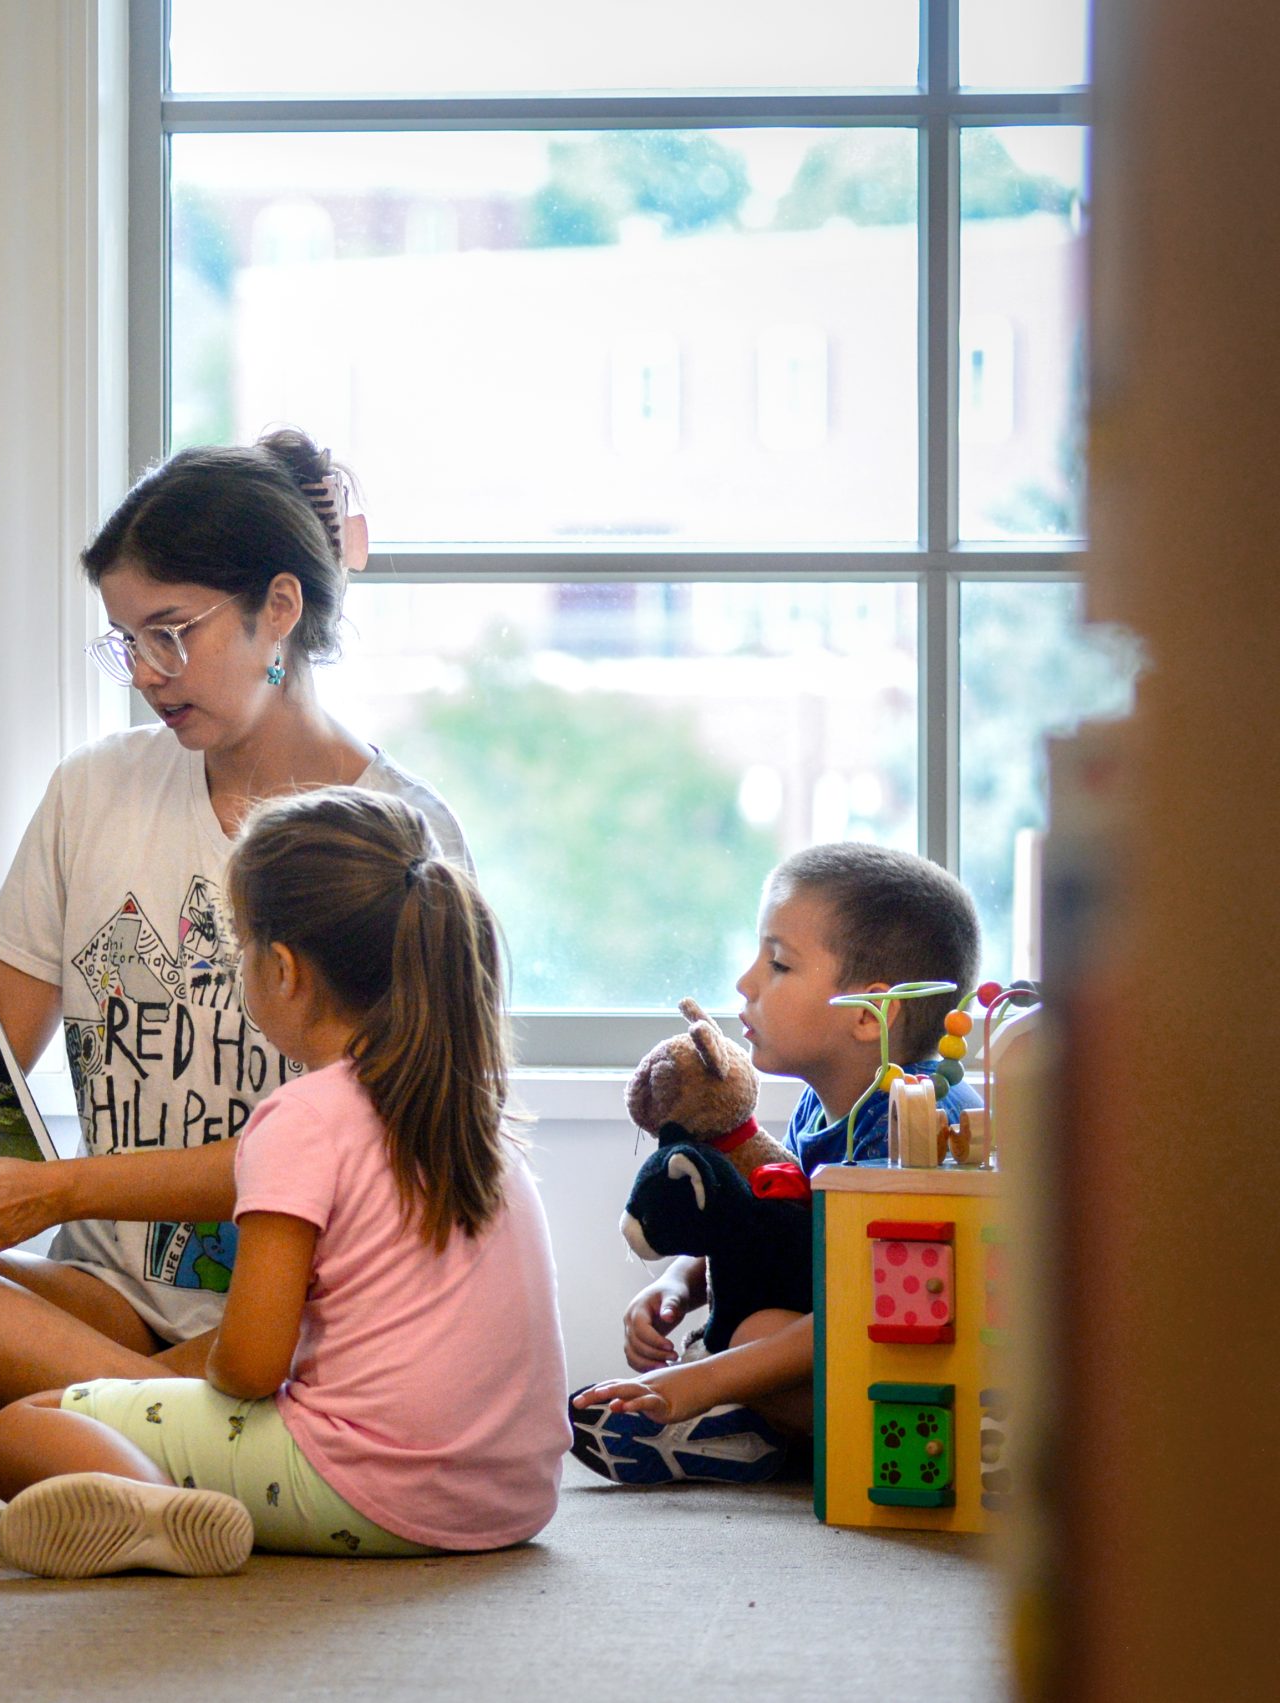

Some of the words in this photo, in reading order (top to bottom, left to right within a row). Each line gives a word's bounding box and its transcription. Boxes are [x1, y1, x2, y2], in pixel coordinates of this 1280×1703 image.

[105, 996, 195, 1080] RED
[163, 1250, 180, 1283] LIFE
[175, 1233, 186, 1249] IS
